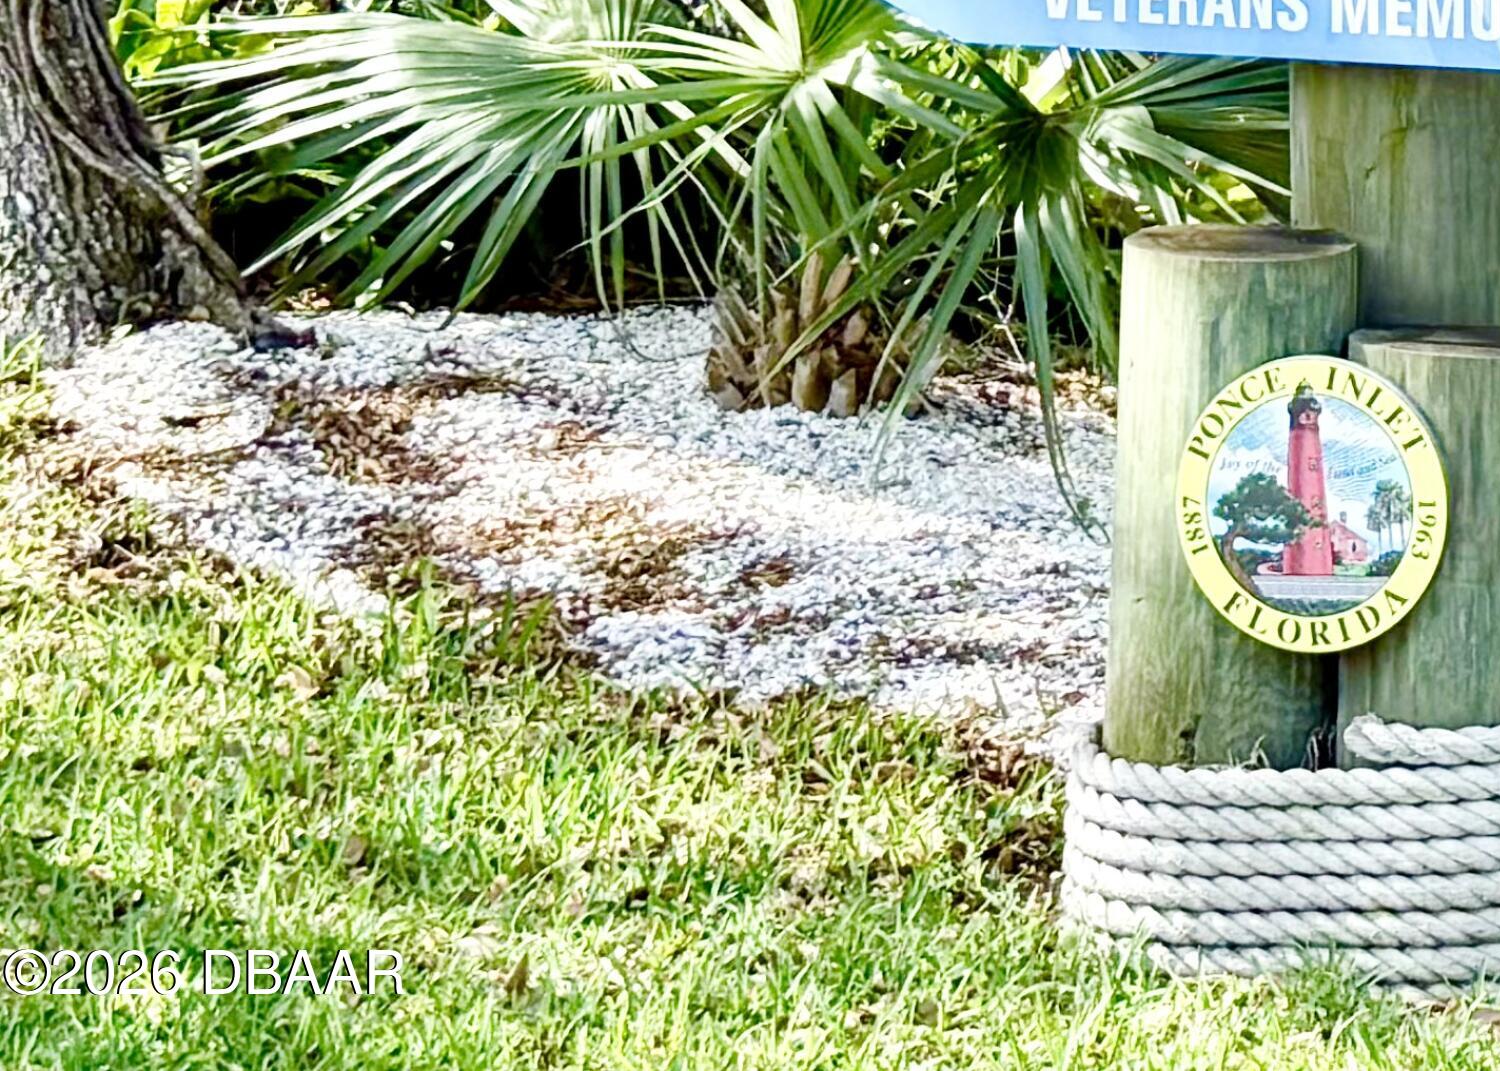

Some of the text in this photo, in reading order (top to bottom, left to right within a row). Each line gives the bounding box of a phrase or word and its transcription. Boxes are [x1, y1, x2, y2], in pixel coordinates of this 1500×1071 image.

[1187, 365, 1428, 461] PONCE INLET
[1182, 495, 1206, 556] 1887
[1411, 500, 1437, 560] 1963
[1222, 589, 1409, 647] FLORIDA
